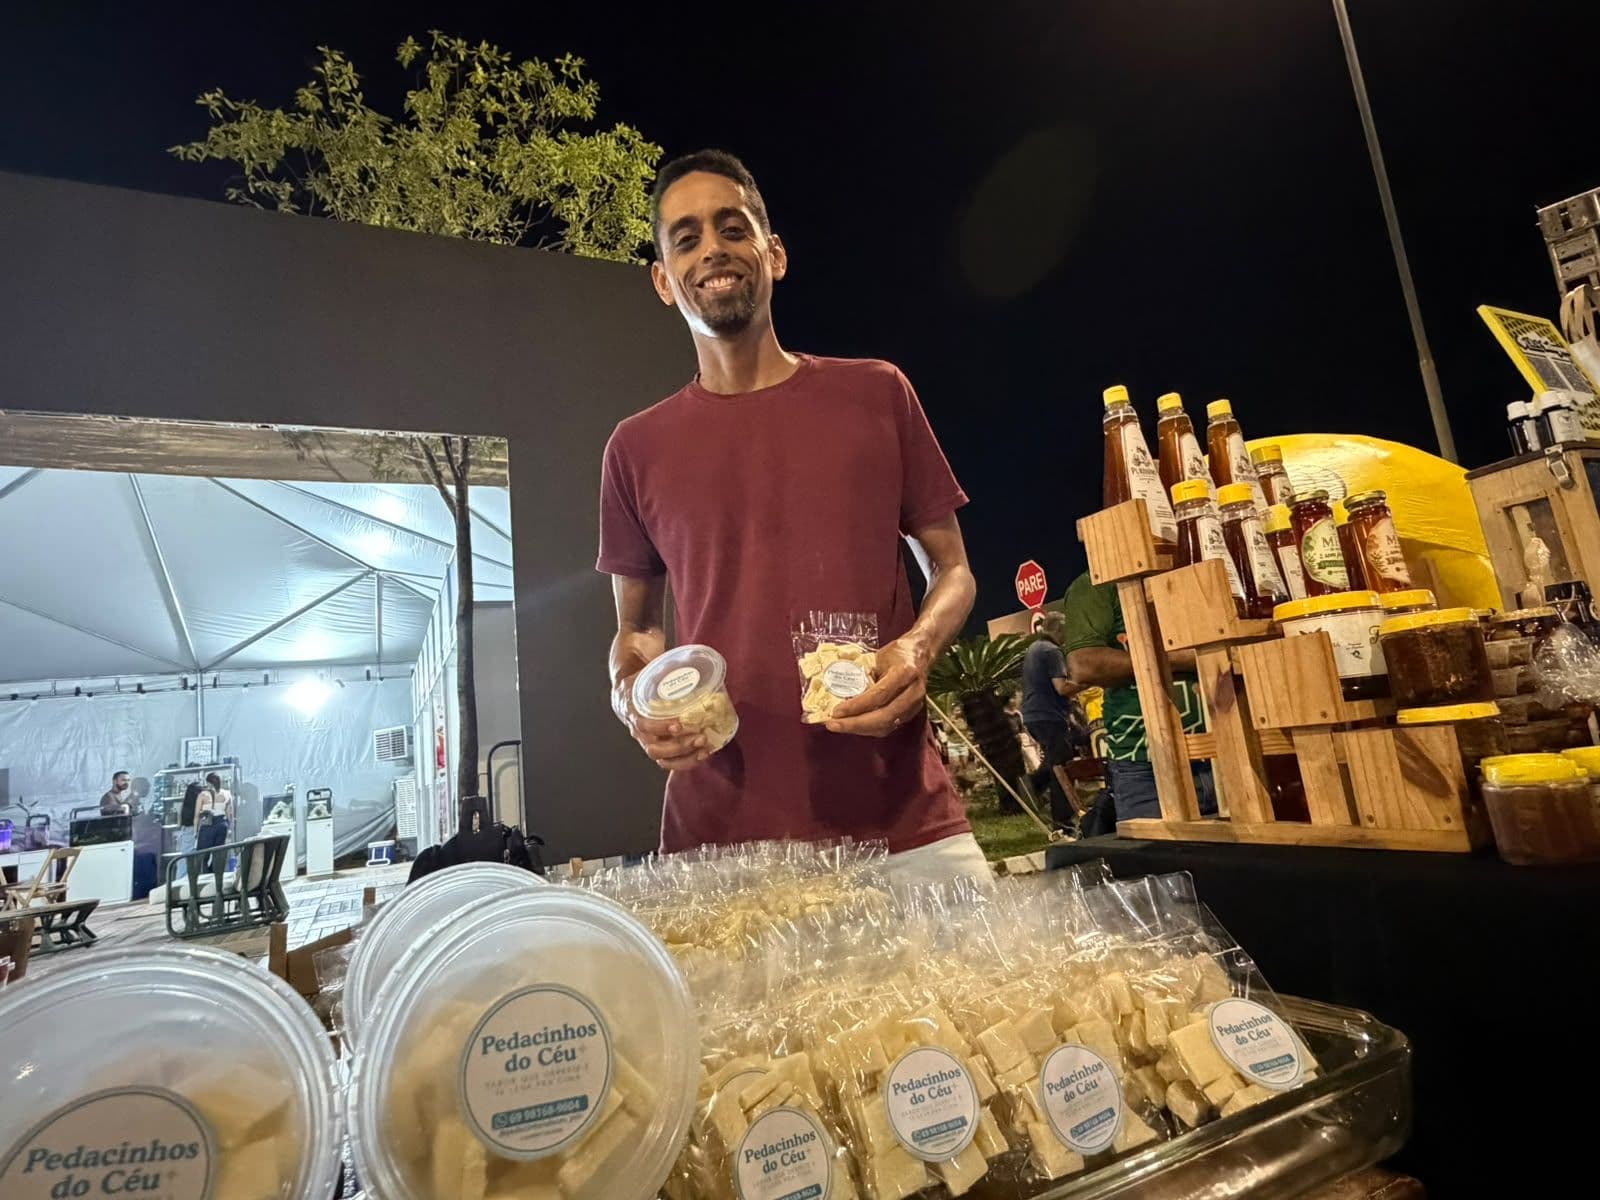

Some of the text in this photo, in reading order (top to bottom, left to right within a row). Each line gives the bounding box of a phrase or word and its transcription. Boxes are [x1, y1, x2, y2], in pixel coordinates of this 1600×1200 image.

[1018, 572, 1045, 597] PARE
[481, 1023, 597, 1055] Pedacinhos
[1216, 1014, 1273, 1037] Pedacinhos
[1235, 1027, 1271, 1045] do Céu
[505, 1045, 576, 1072] do Céu
[892, 1068, 961, 1096] Pedacinhos
[1046, 1061, 1104, 1095] Pedacinhos
[1063, 1078, 1098, 1103] do Céu
[910, 1084, 952, 1106] do Céu
[23, 1139, 199, 1173] Pedacinhos
[744, 1131, 816, 1163] Pedacinhos
[762, 1149, 806, 1174] do Céu
[51, 1168, 160, 1200] do Céu
